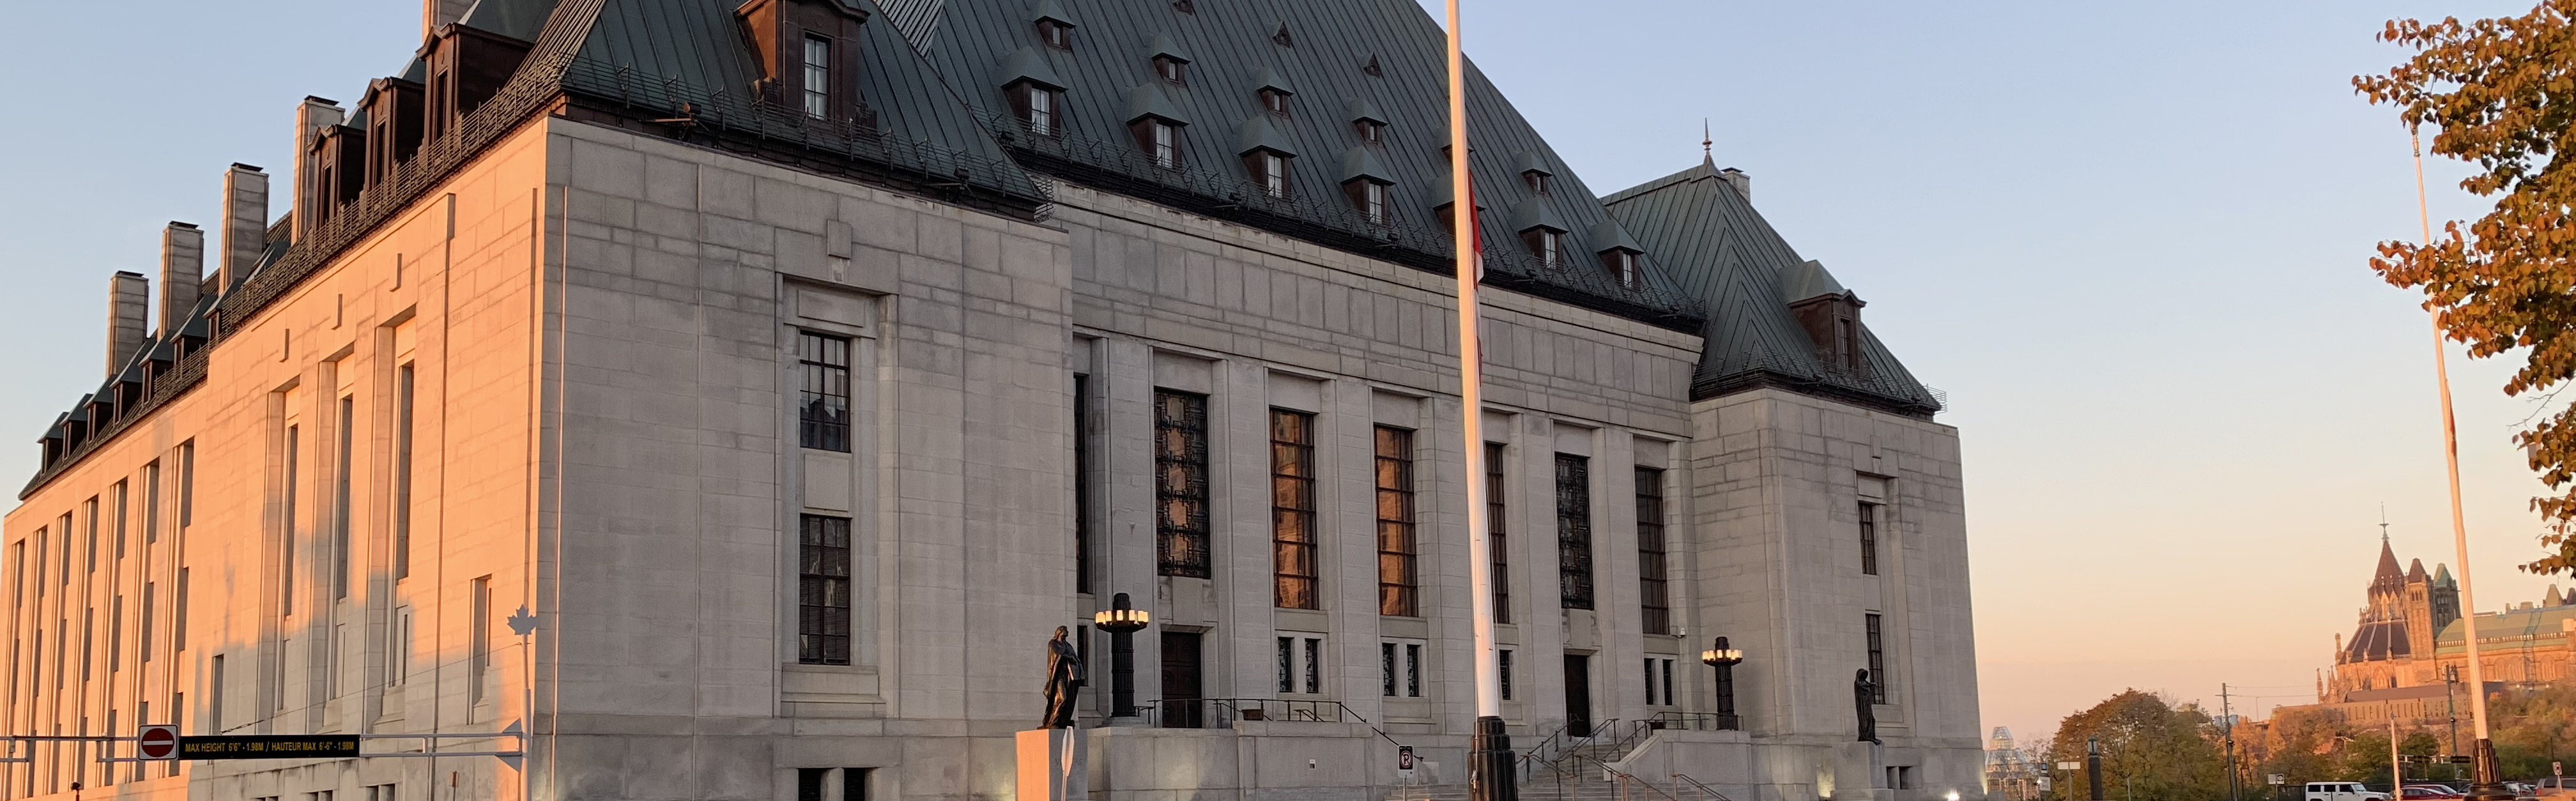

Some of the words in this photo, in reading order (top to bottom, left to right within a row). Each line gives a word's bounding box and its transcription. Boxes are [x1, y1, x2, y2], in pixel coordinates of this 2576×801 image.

[185, 743, 199, 752] MAX
[201, 743, 226, 752] HEIGHT
[266, 741, 270, 752] /
[272, 742, 301, 751] HAUTEUR
[303, 742, 316, 751] MAX
